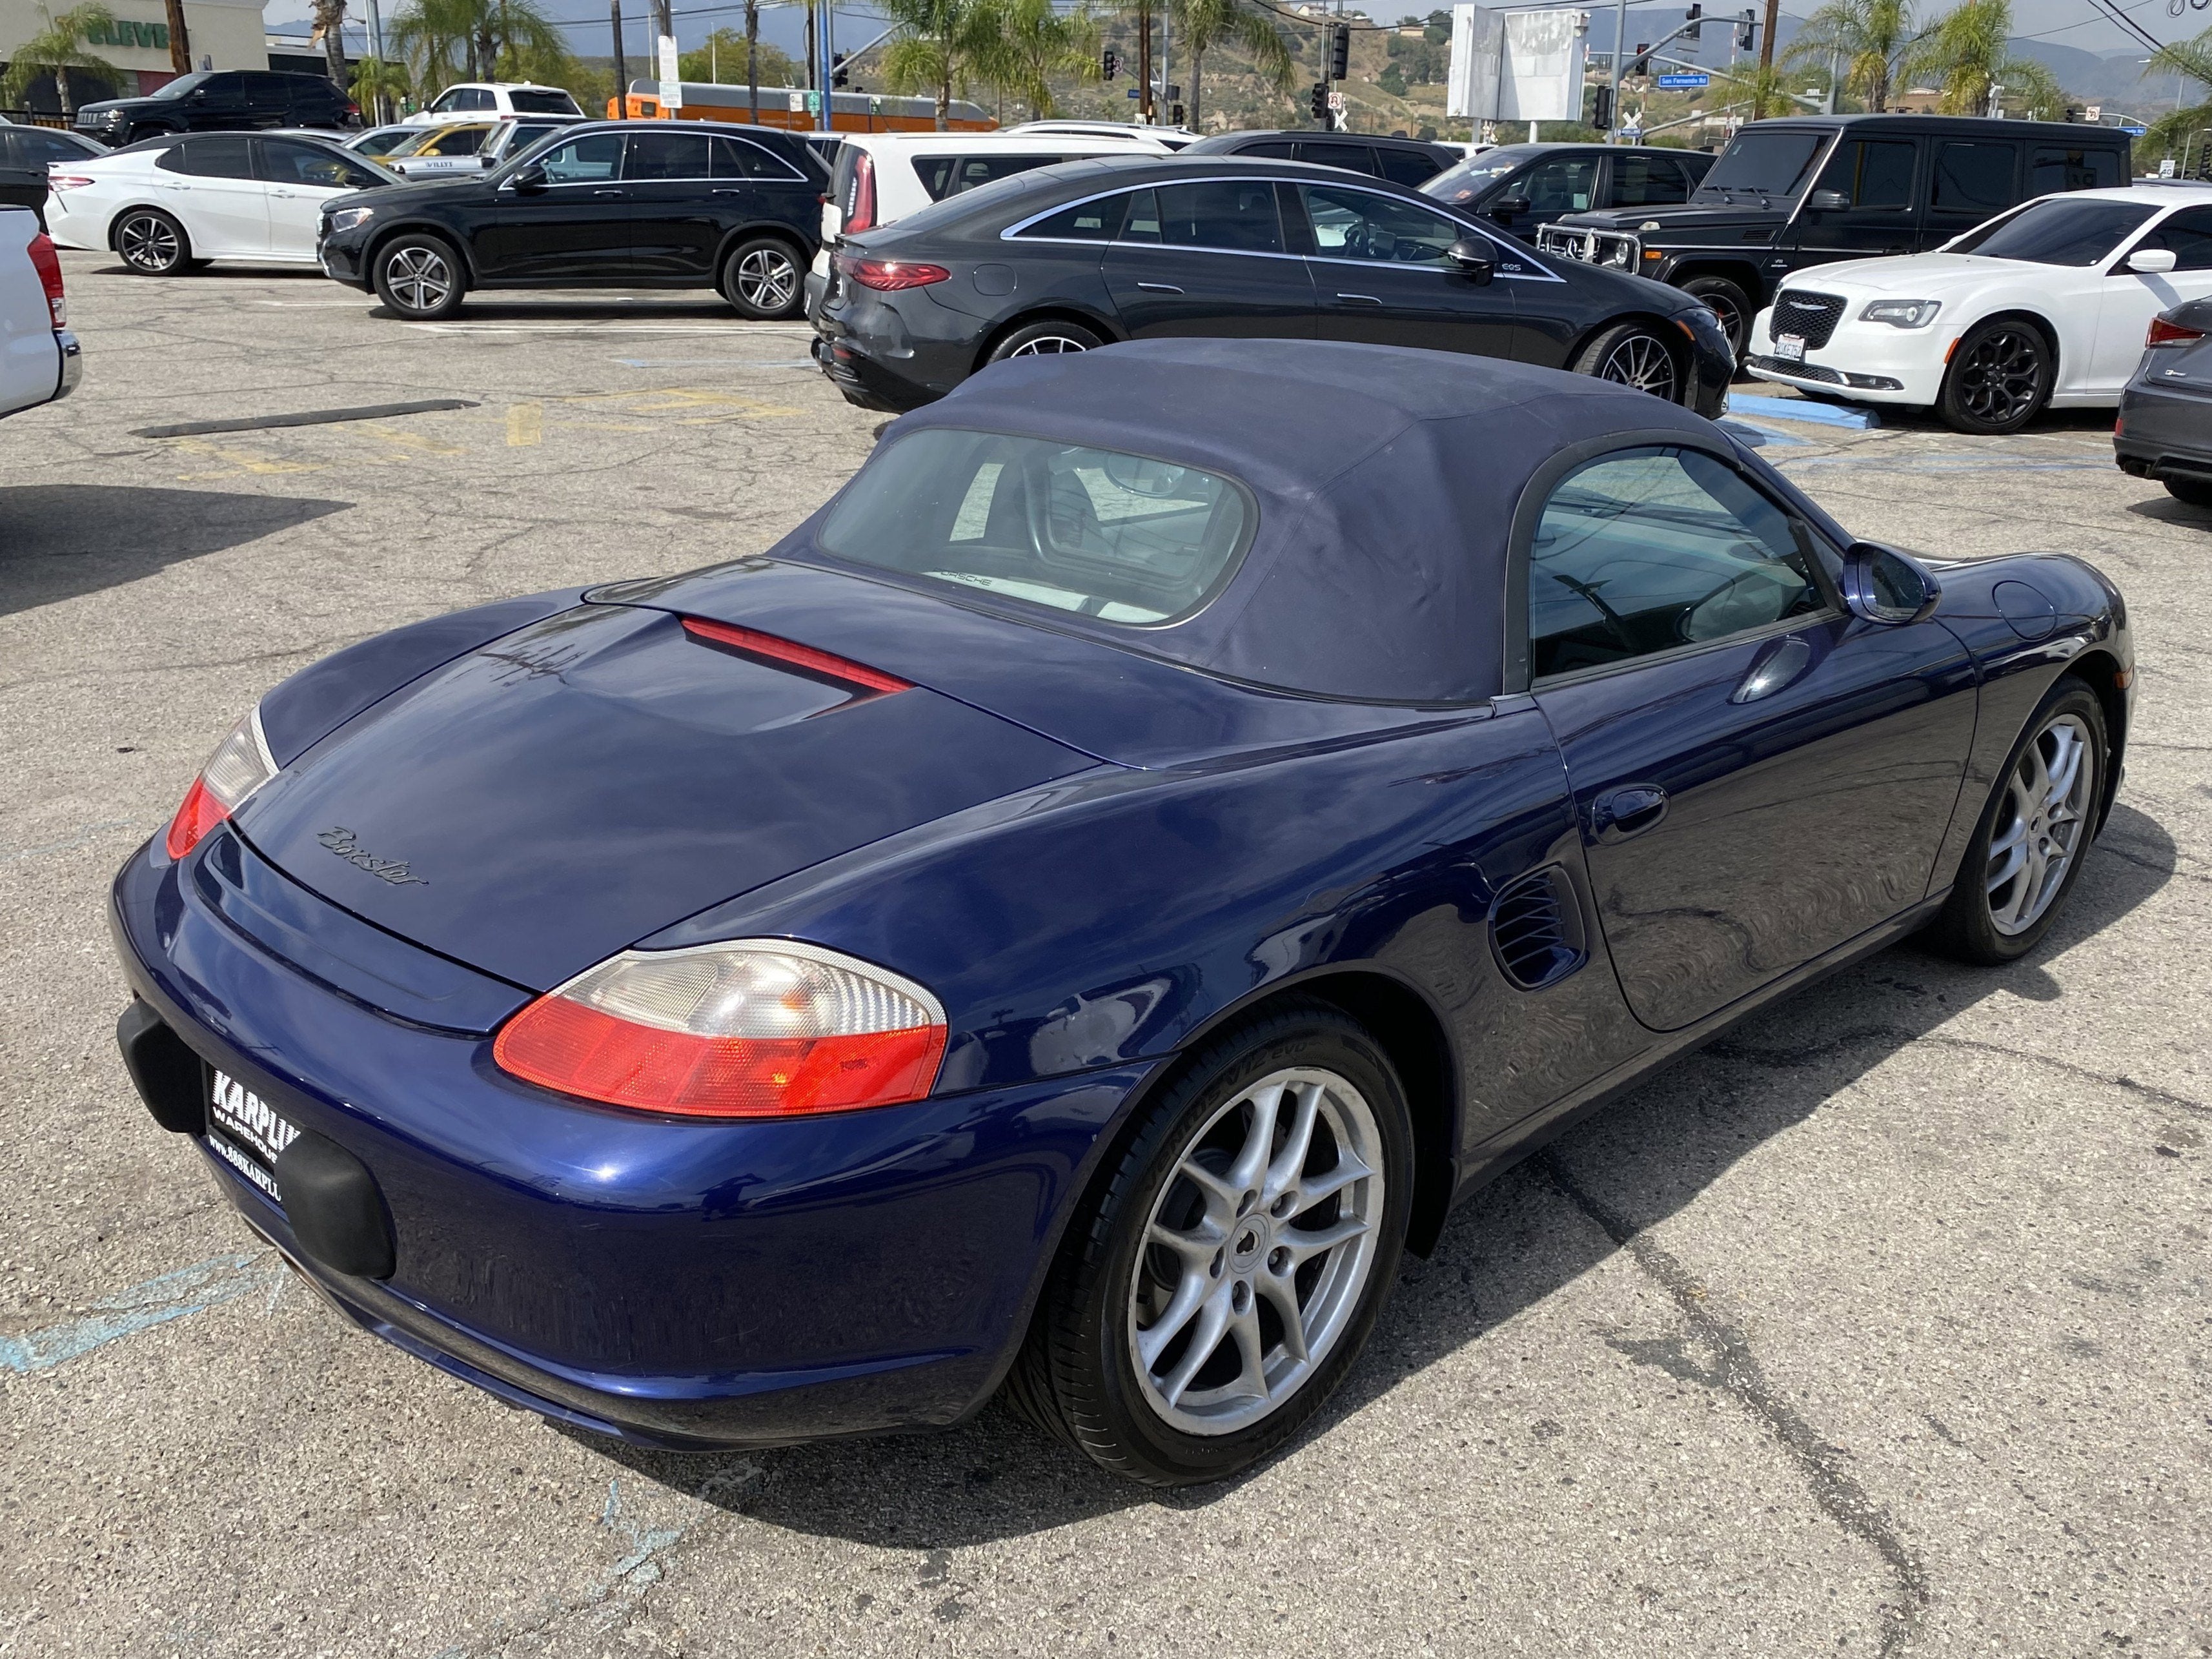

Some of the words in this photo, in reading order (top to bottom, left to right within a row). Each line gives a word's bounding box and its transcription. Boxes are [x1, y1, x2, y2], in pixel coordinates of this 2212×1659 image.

[87, 19, 170, 49] ELEVE
[933, 567, 993, 587] PORSCHE
[317, 826, 430, 885] Boxster
[212, 1070, 301, 1153] KARPLU
[212, 1106, 278, 1164] WAREHOUS
[208, 1134, 281, 1202] www.888KARPLU
